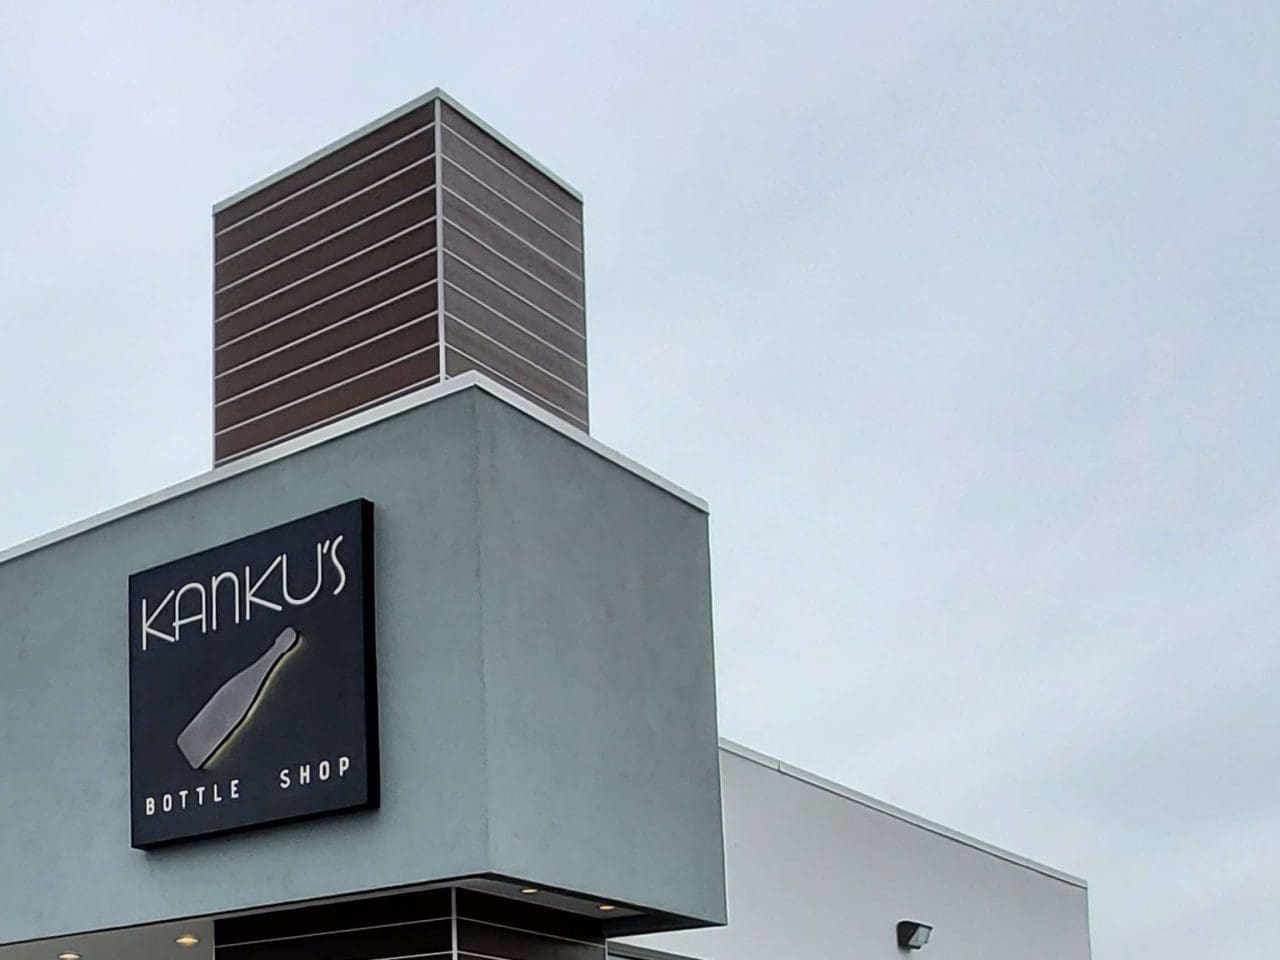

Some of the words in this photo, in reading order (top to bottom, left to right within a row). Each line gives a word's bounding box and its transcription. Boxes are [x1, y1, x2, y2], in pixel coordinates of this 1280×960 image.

[141, 534, 347, 651] KANKU'S
[145, 779, 240, 816] BOTTLE
[280, 756, 350, 789] SHOP
